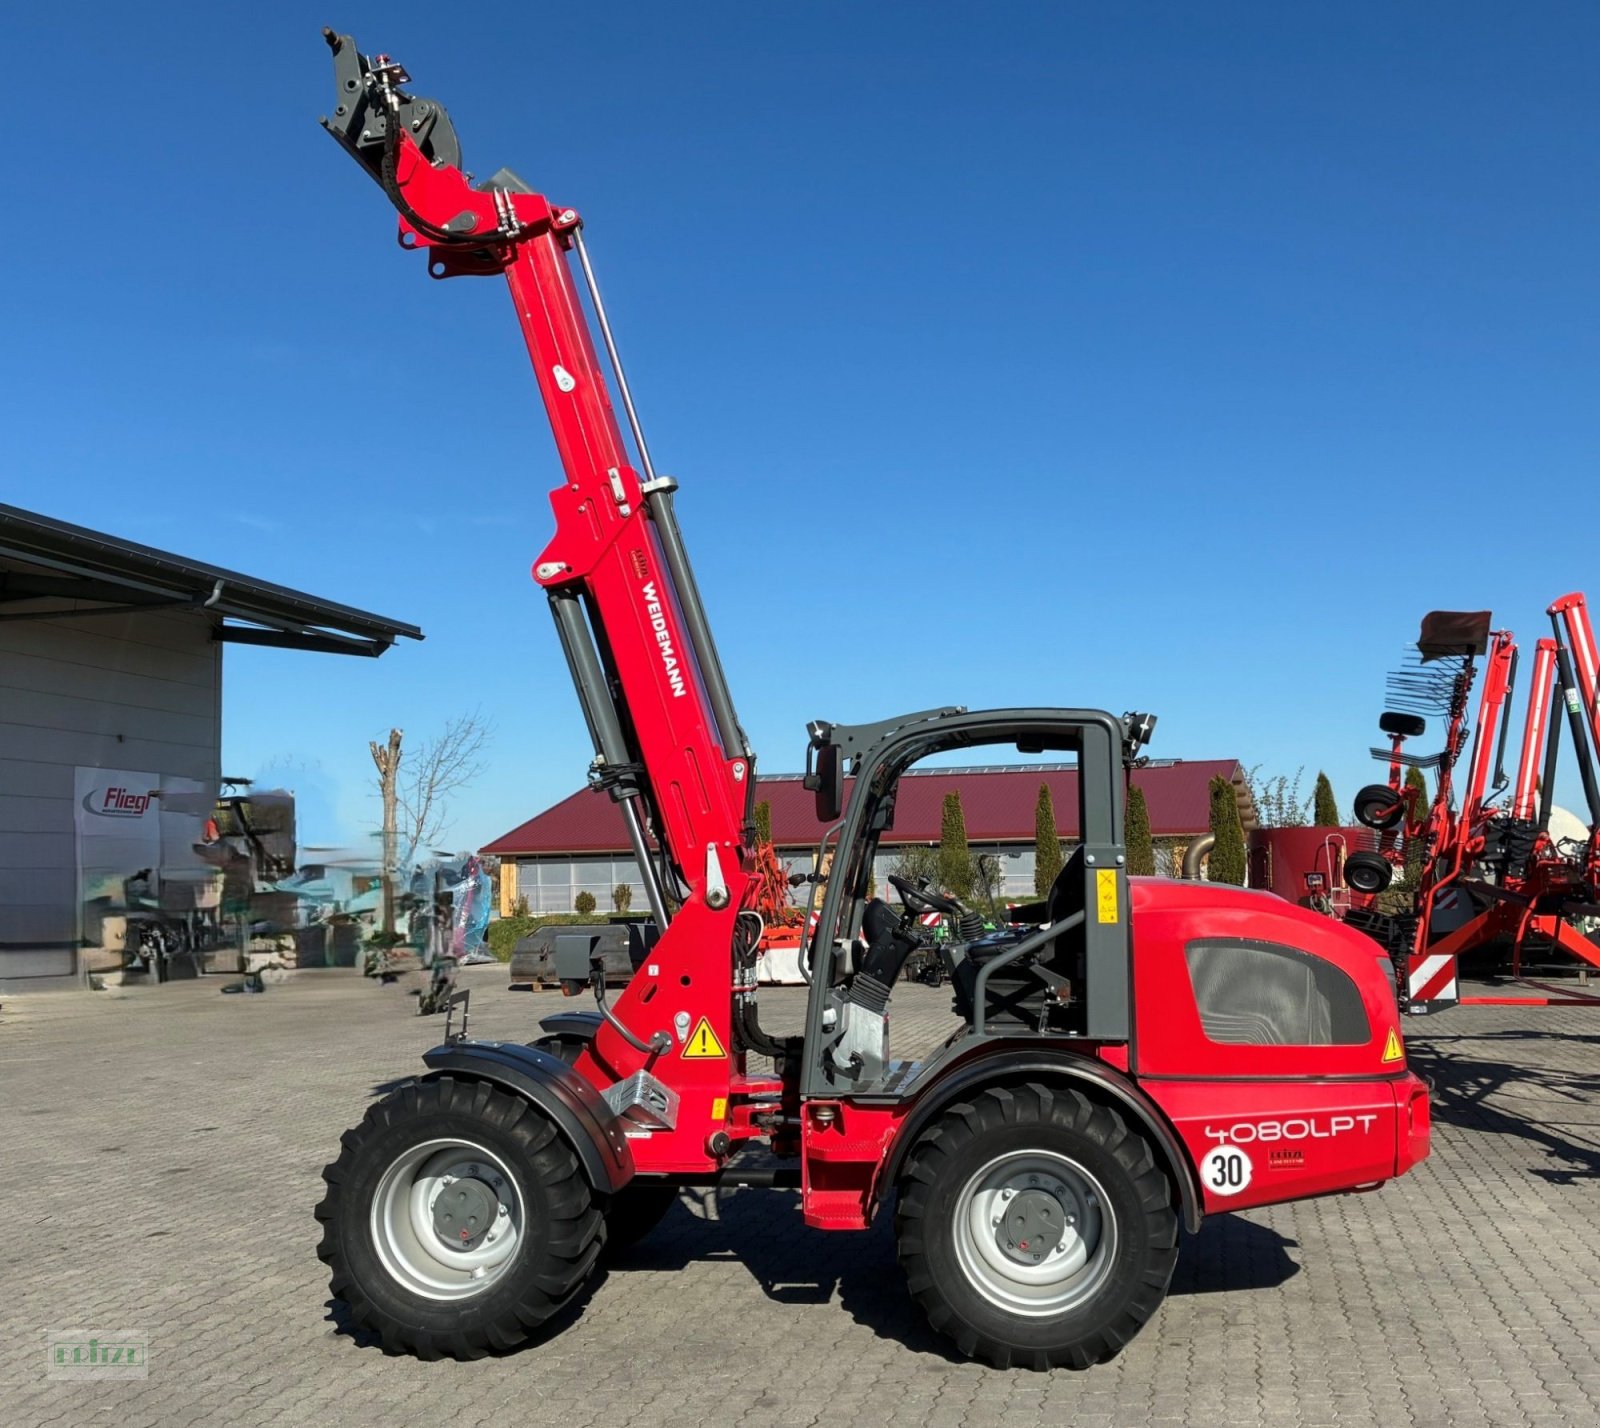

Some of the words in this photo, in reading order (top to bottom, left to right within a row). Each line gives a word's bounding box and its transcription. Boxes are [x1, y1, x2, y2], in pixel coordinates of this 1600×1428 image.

[642, 581, 686, 698] WEIDEMANN
[1205, 1115, 1377, 1144] 4080LPT
[1212, 1154, 1242, 1187] 30
